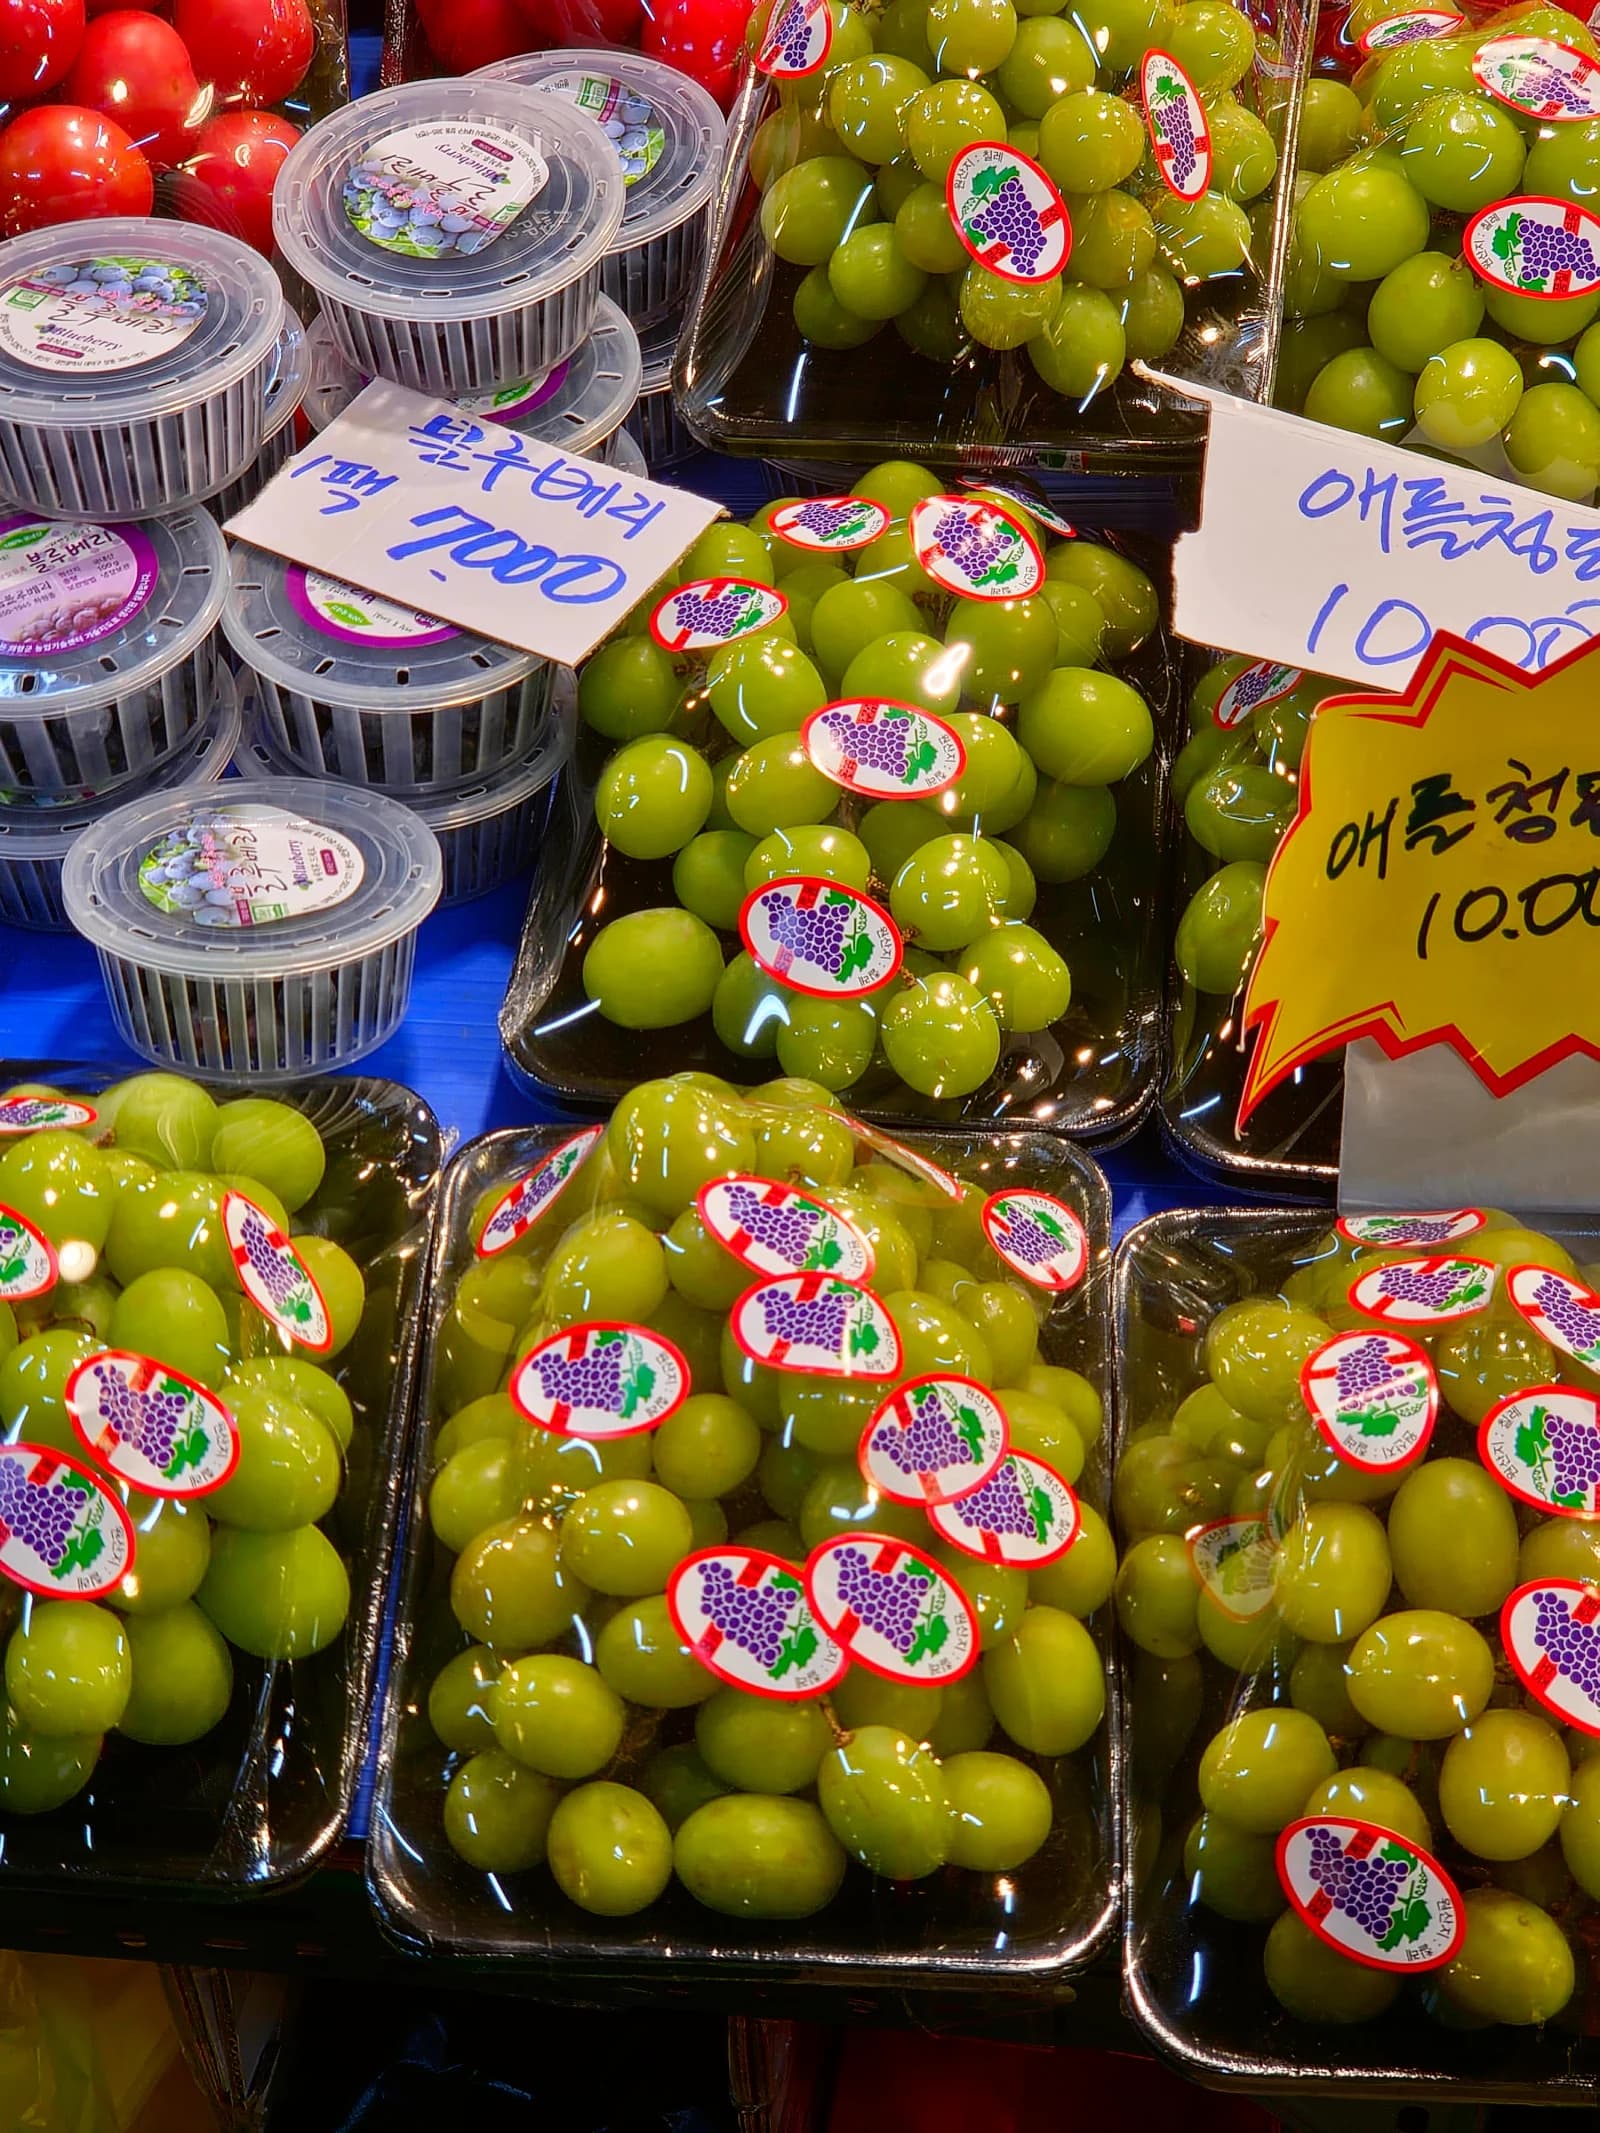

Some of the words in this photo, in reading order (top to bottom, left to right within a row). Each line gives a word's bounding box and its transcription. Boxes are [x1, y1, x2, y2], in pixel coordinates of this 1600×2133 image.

[434, 143, 496, 180] Blueberry
[953, 158, 976, 190] 원산지
[982, 149, 1004, 164] 칠레
[380, 154, 497, 217] 블루베리
[1480, 212, 1501, 231] 칠레
[1473, 240, 1494, 269] 원산지
[47, 293, 178, 336] 블루베리
[55, 325, 123, 351] Blueberry
[408, 413, 667, 540] 블루베리
[25, 529, 113, 574] 블루베리
[937, 733, 956, 764] 원산지
[925, 769, 947, 787] 칠레
[229, 826, 289, 900] 블루베리
[287, 839, 307, 886] Blueberry
[876, 926, 892, 960] 원산지
[858, 968, 881, 987] 칠레
[1497, 1404, 1522, 1430] 칠레
[1490, 1439, 1520, 1481] 원산지
[1436, 1897, 1454, 1939] 원산지
[1404, 1943, 1433, 1962] 칠레
